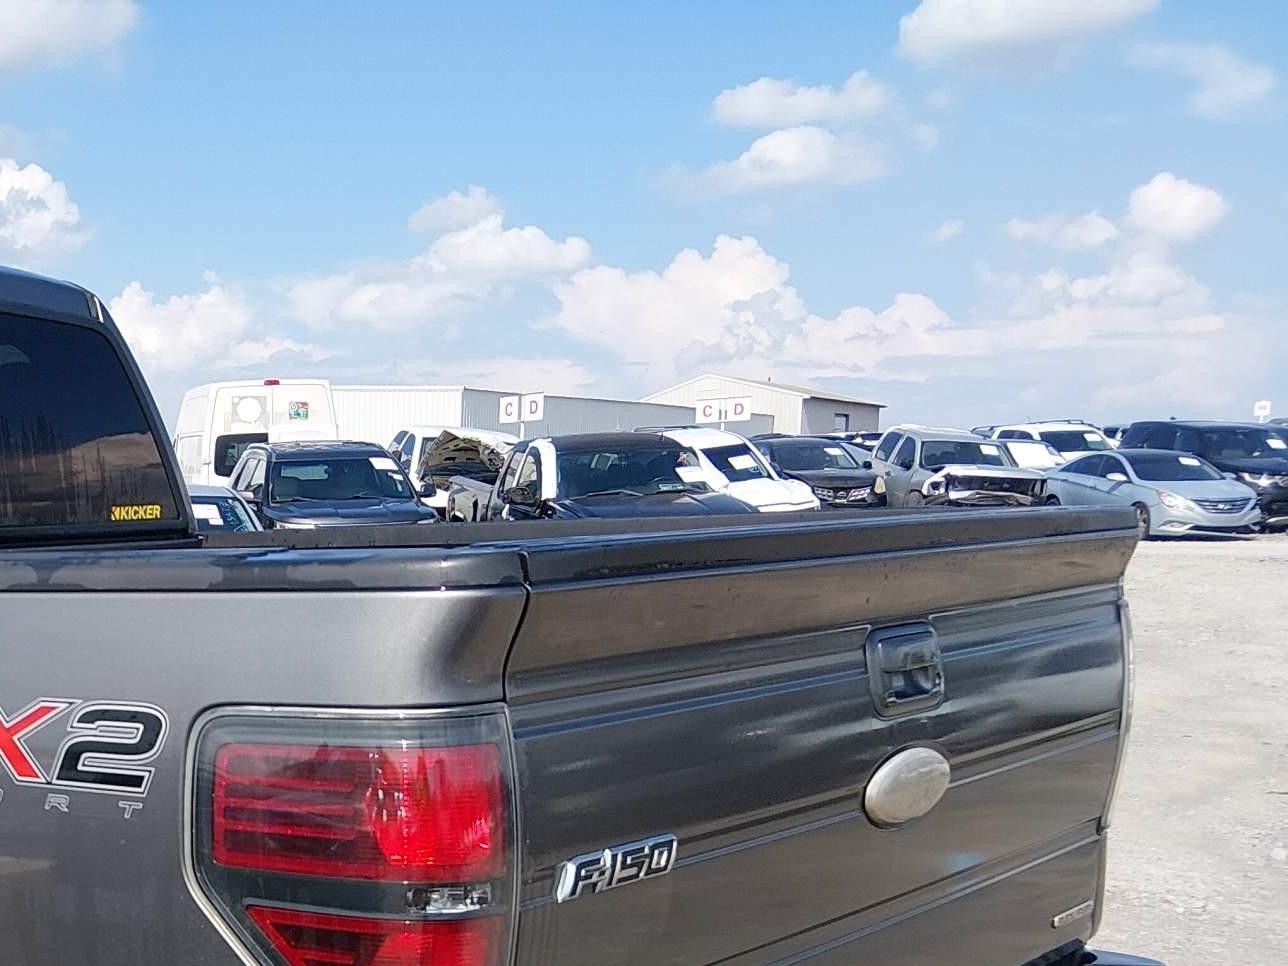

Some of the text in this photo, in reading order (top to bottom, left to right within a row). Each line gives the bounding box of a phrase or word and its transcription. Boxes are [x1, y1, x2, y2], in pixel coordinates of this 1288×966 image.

[505, 400, 538, 417] C D
[703, 403, 745, 418] C D
[121, 504, 161, 520] KICKER
